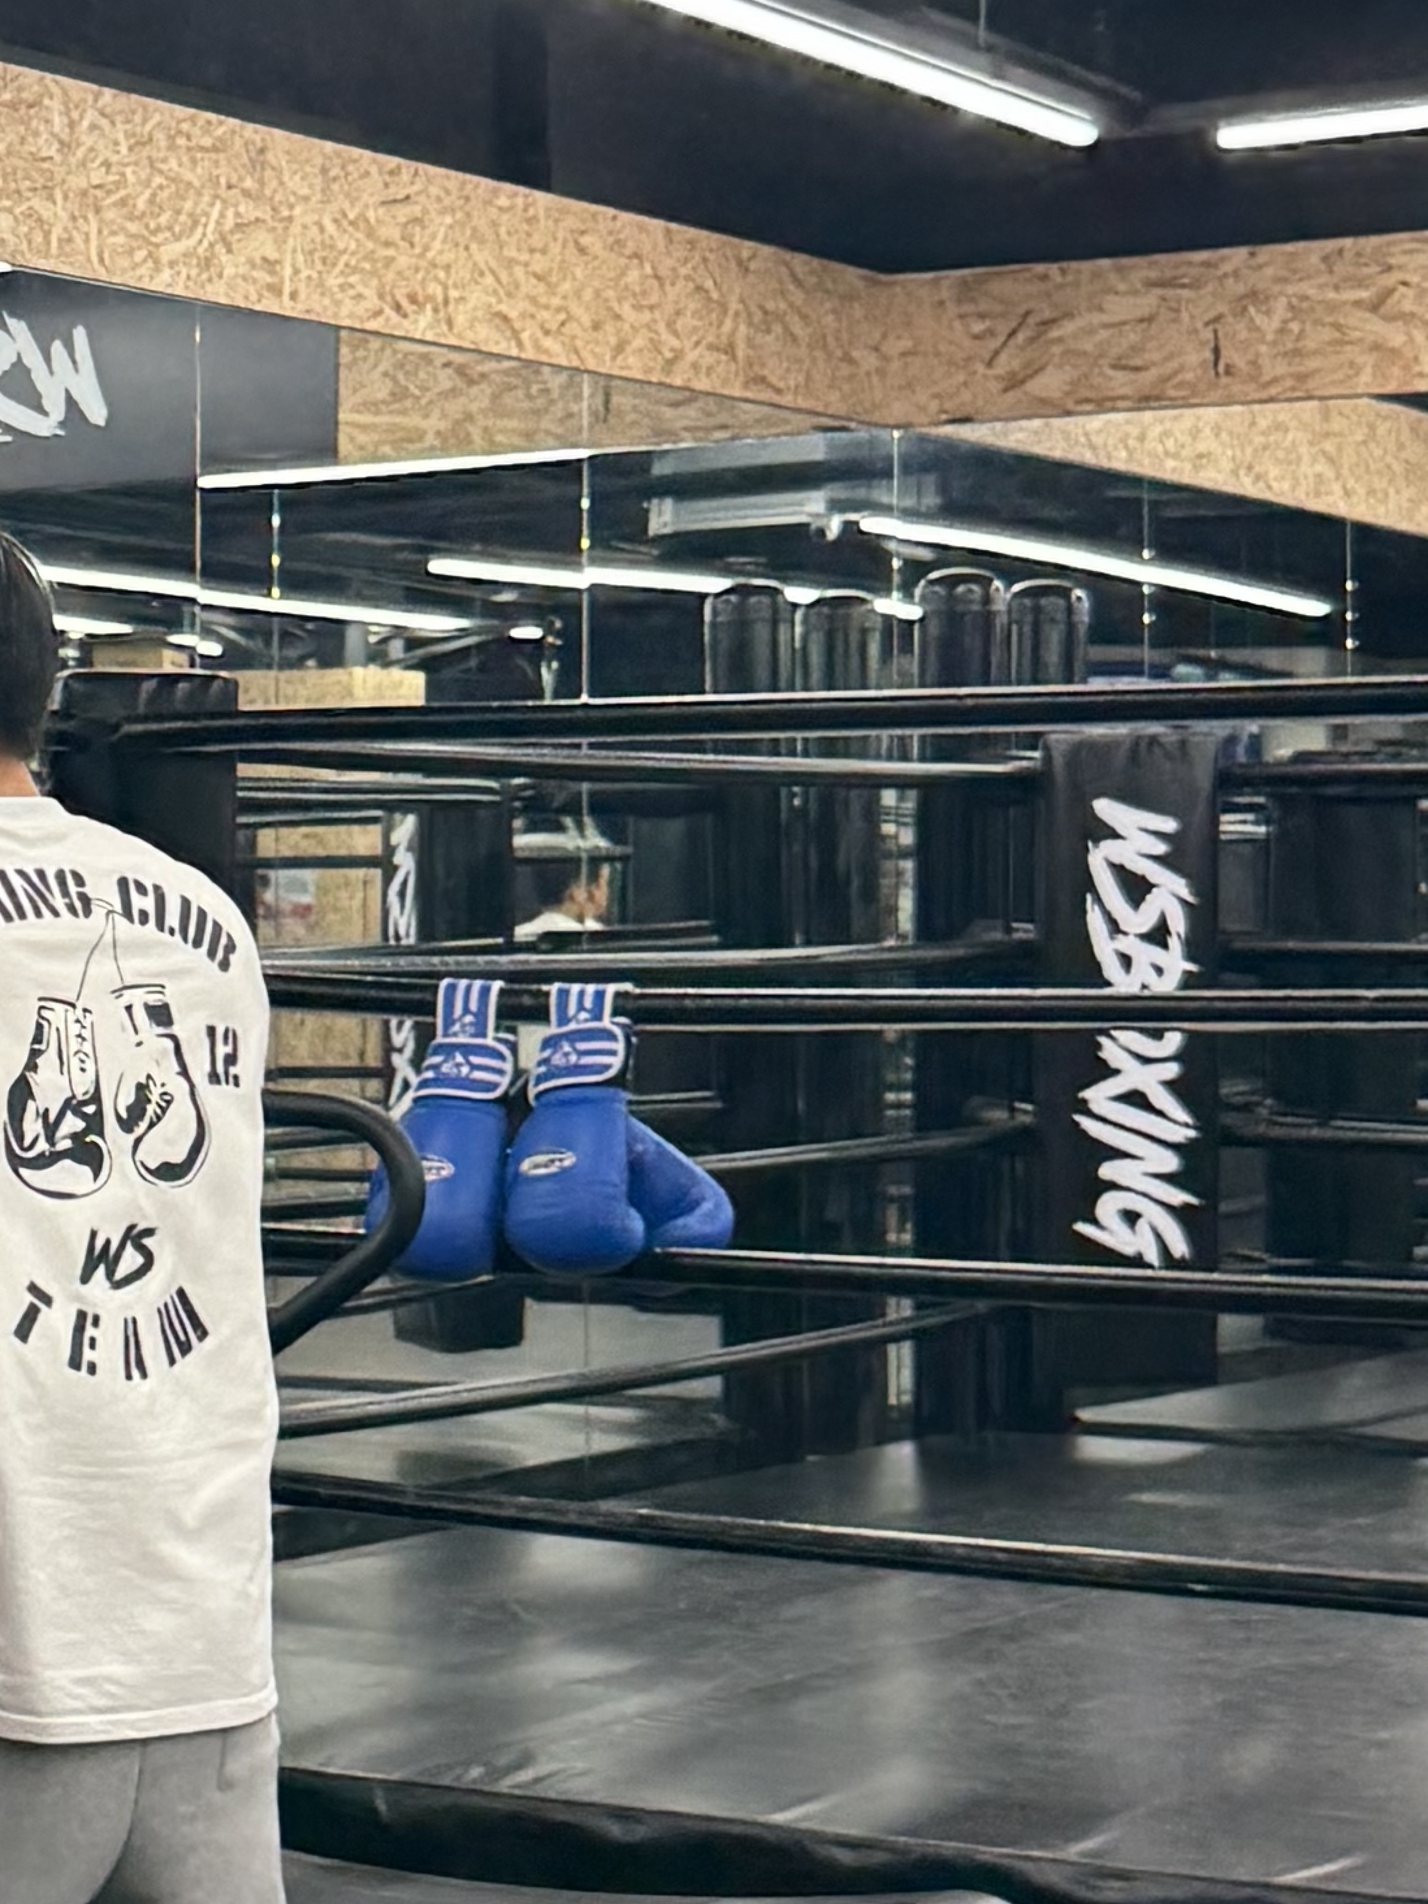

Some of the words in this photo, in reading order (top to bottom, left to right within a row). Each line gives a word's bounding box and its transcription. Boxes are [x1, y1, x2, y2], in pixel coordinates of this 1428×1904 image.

[114, 876, 237, 973] CLUB
[206, 1025, 240, 1087] 12
[80, 1223, 158, 1290] WS
[13, 1280, 210, 1381] TEAM
